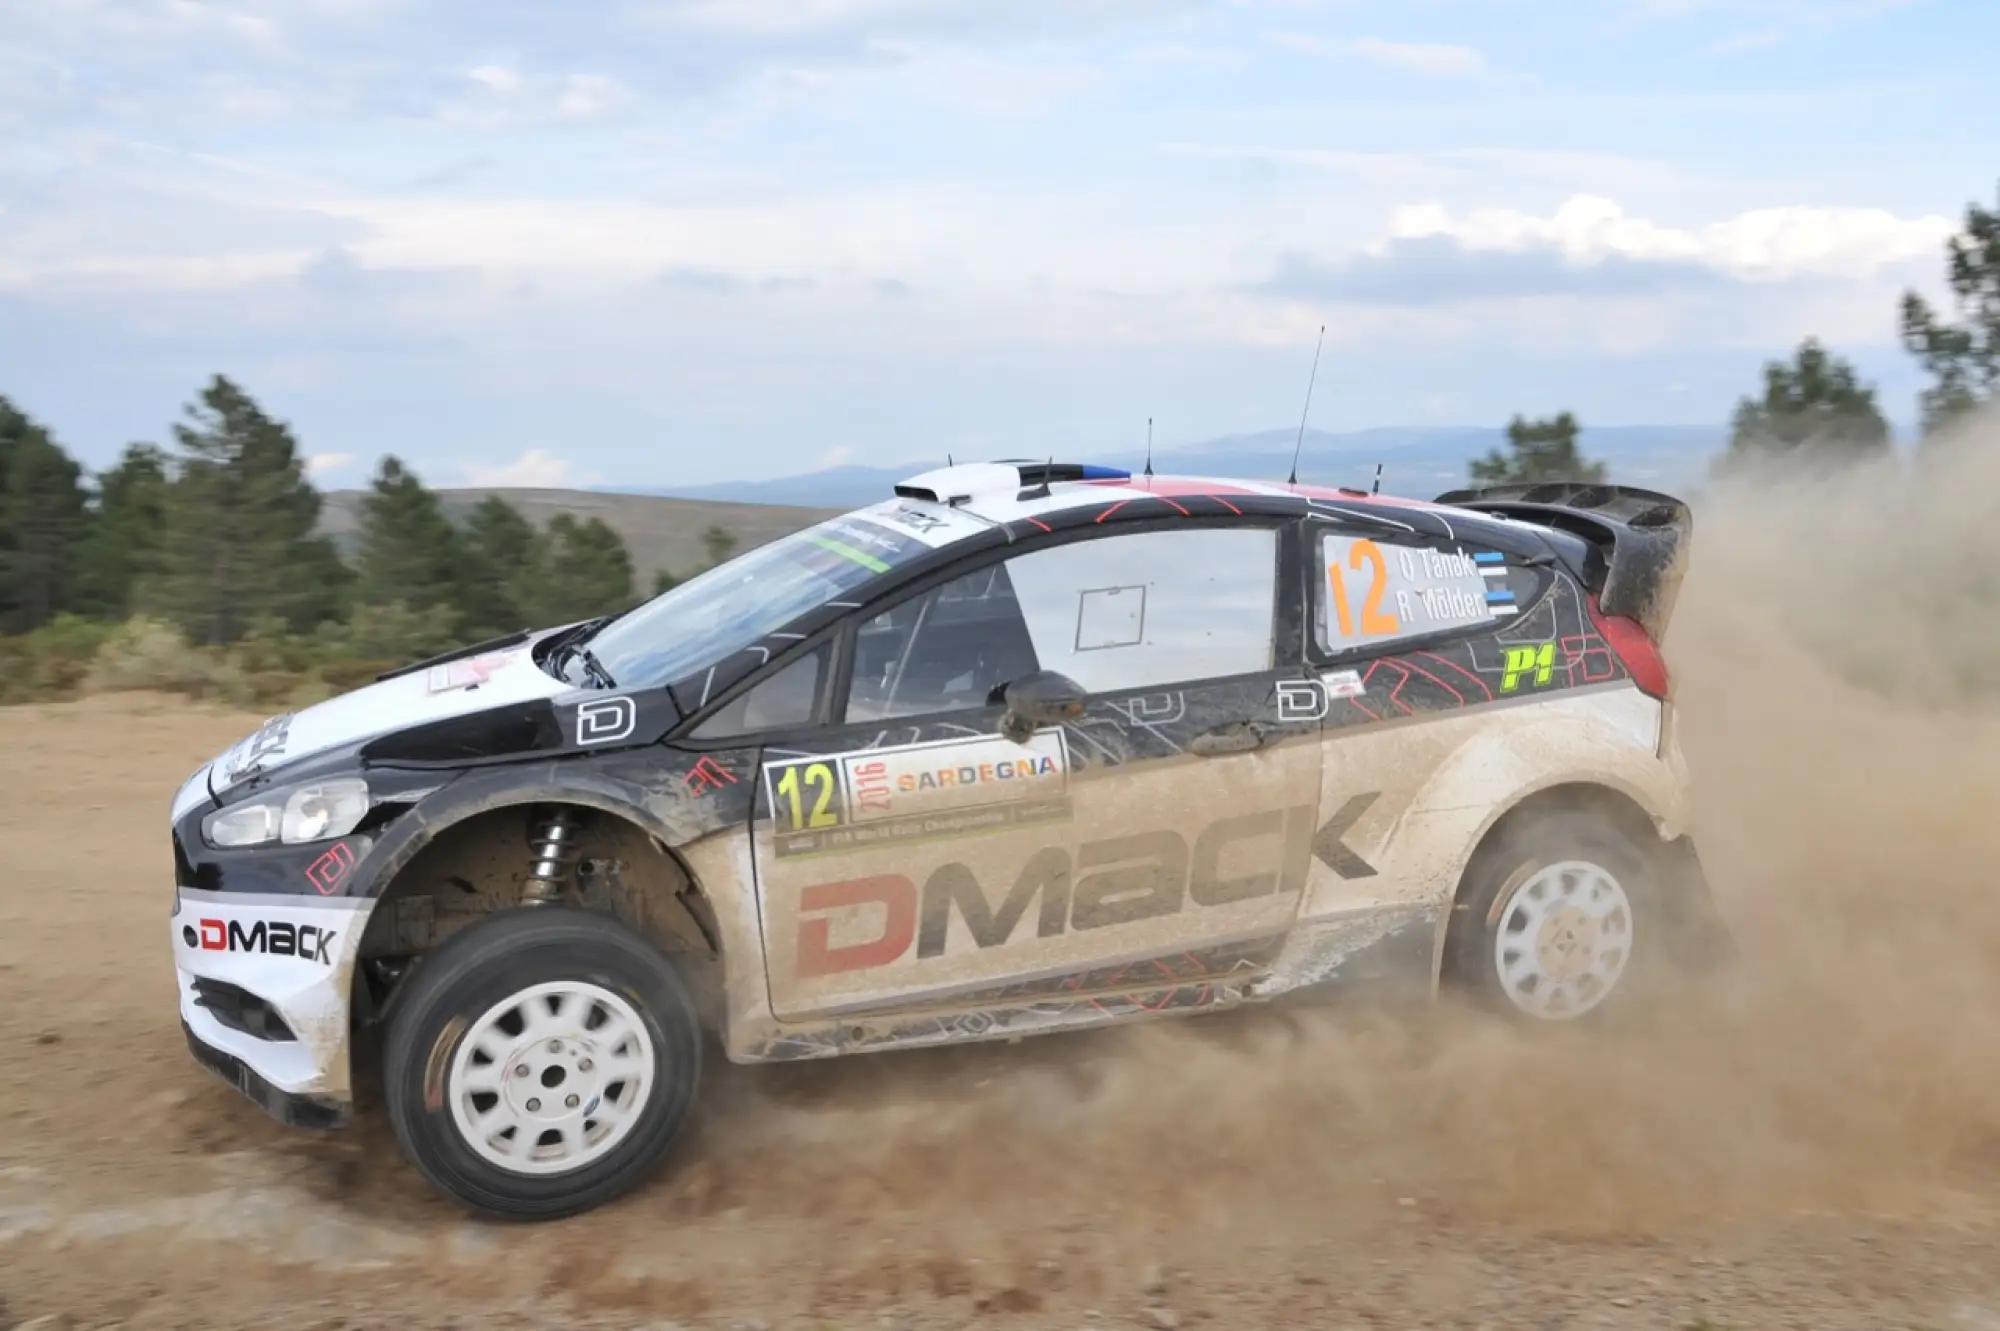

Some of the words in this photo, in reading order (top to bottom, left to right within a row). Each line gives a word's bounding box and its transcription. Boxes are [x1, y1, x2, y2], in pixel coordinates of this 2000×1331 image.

[1328, 538, 1398, 637] 12
[1417, 547, 1475, 579] Tänak
[1398, 591, 1415, 623] R
[1501, 641, 1555, 691] P1
[777, 763, 837, 831] 12
[854, 761, 891, 812] 2016
[898, 755, 1057, 792] SARDEGNA
